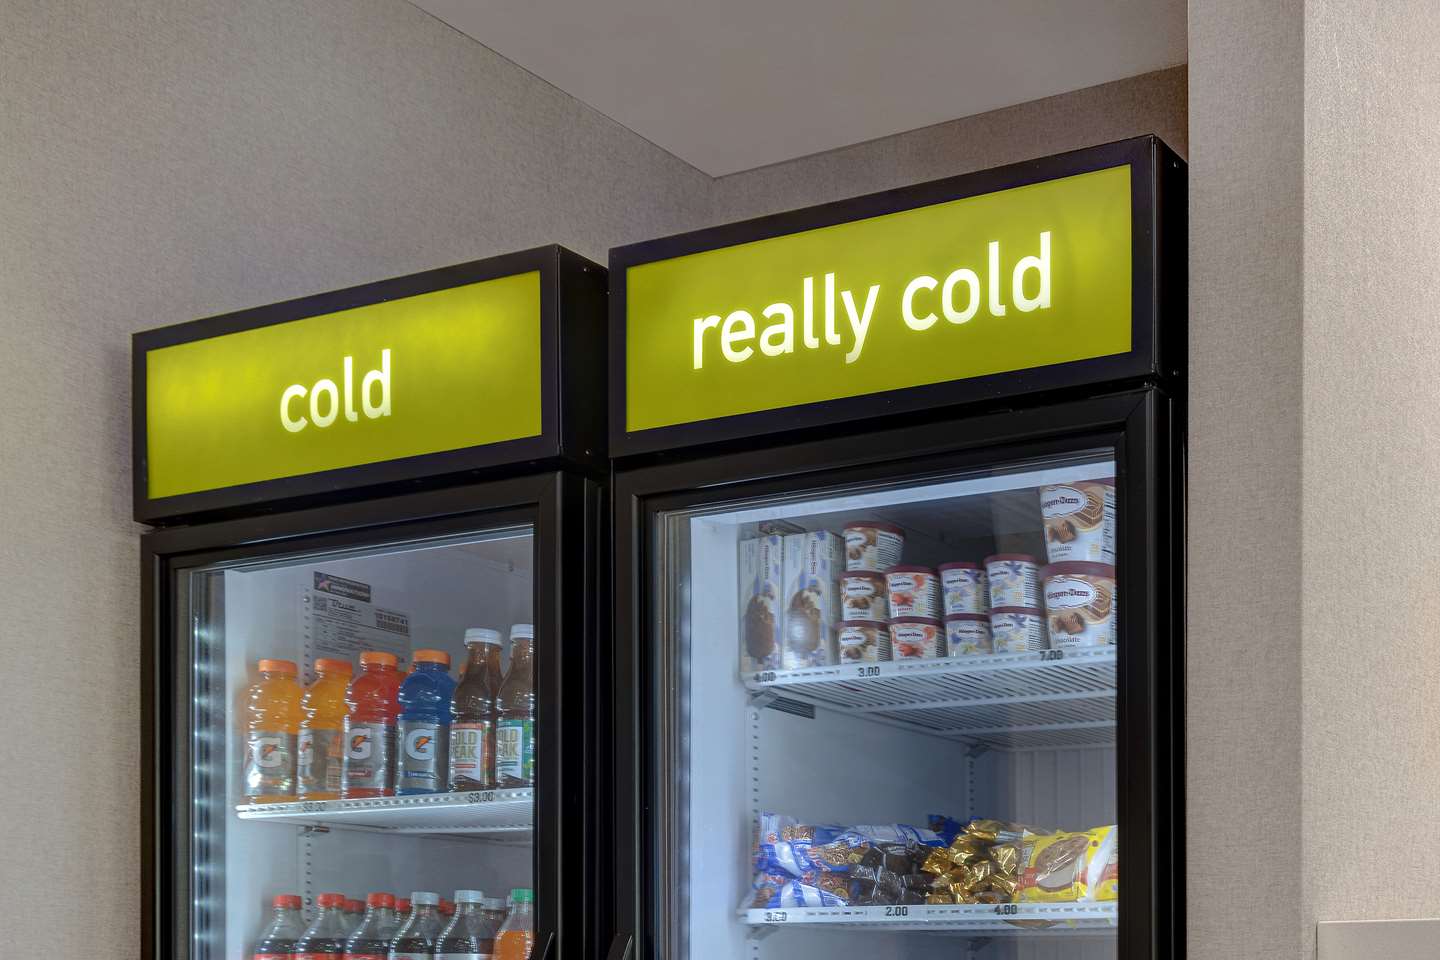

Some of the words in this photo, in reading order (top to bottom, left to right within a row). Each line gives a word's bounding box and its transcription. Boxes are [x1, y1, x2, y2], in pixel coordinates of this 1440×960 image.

[693, 273, 882, 365] really
[901, 231, 1053, 333] cold
[279, 349, 393, 433] cold
[858, 666, 880, 679] 3.00
[885, 905, 909, 917] 2.00
